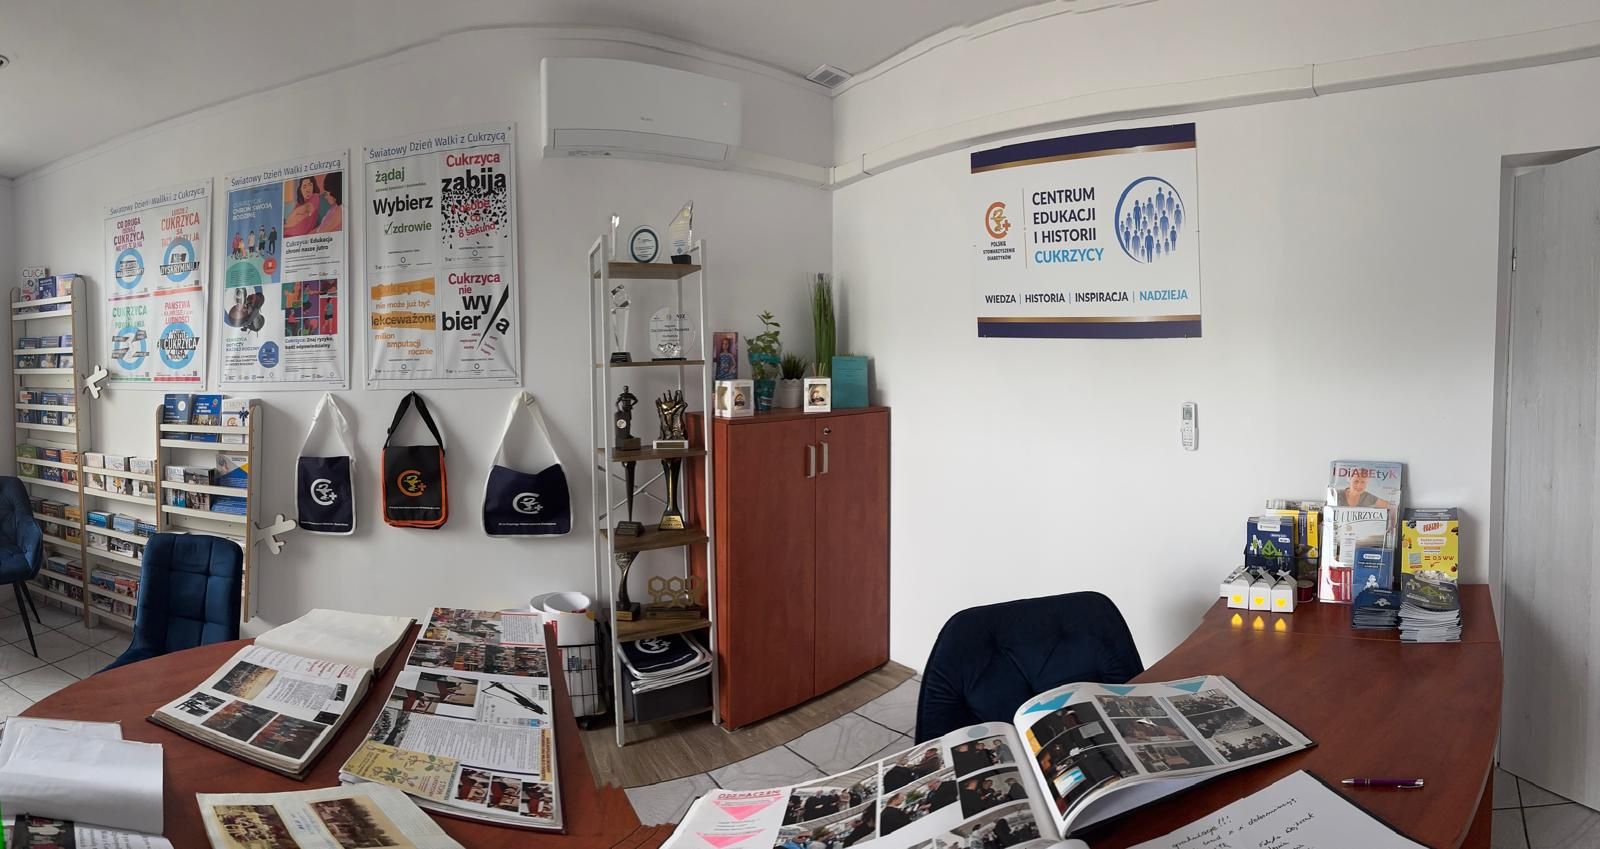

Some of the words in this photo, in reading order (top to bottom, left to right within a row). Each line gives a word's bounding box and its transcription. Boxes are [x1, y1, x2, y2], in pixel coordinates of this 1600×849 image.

[369, 145, 408, 159] Światowy
[409, 139, 433, 152] Dzień
[434, 135, 458, 147] Walki
[467, 131, 506, 143] Cukrzycą
[446, 152, 500, 167] Cukrzyca
[231, 174, 262, 187] Światowy
[263, 168, 282, 180] Dzień
[284, 165, 303, 176] Walki
[309, 160, 341, 172] Cukrzycą
[375, 166, 405, 184] żądaj
[441, 167, 507, 196] zabija
[372, 193, 433, 217] Wybierz
[1032, 187, 1095, 206] CENTRUM
[1033, 207, 1096, 225] EDUKACJI
[392, 220, 432, 234] zdrowie
[458, 229, 464, 238] 8
[466, 221, 497, 236] sekund
[1034, 231, 1038, 244] I
[1041, 227, 1096, 243] HISTORII
[310, 236, 333, 244] Edukacja
[1034, 247, 1105, 264] CUKRZYCY
[448, 272, 501, 286] Cukrzyca
[458, 284, 472, 295] nie
[985, 294, 1017, 304] WIEDZA
[1024, 292, 1066, 303] HISTORIA
[1075, 291, 1129, 303] INSPIRACJA
[1139, 289, 1188, 301] NADZIEJA
[406, 299, 417, 308] już
[418, 299, 430, 308] być
[462, 295, 492, 315] wy
[371, 313, 436, 326] lekceważona
[164, 338, 197, 350] CUKRZYCA
[387, 339, 421, 349] amputacji
